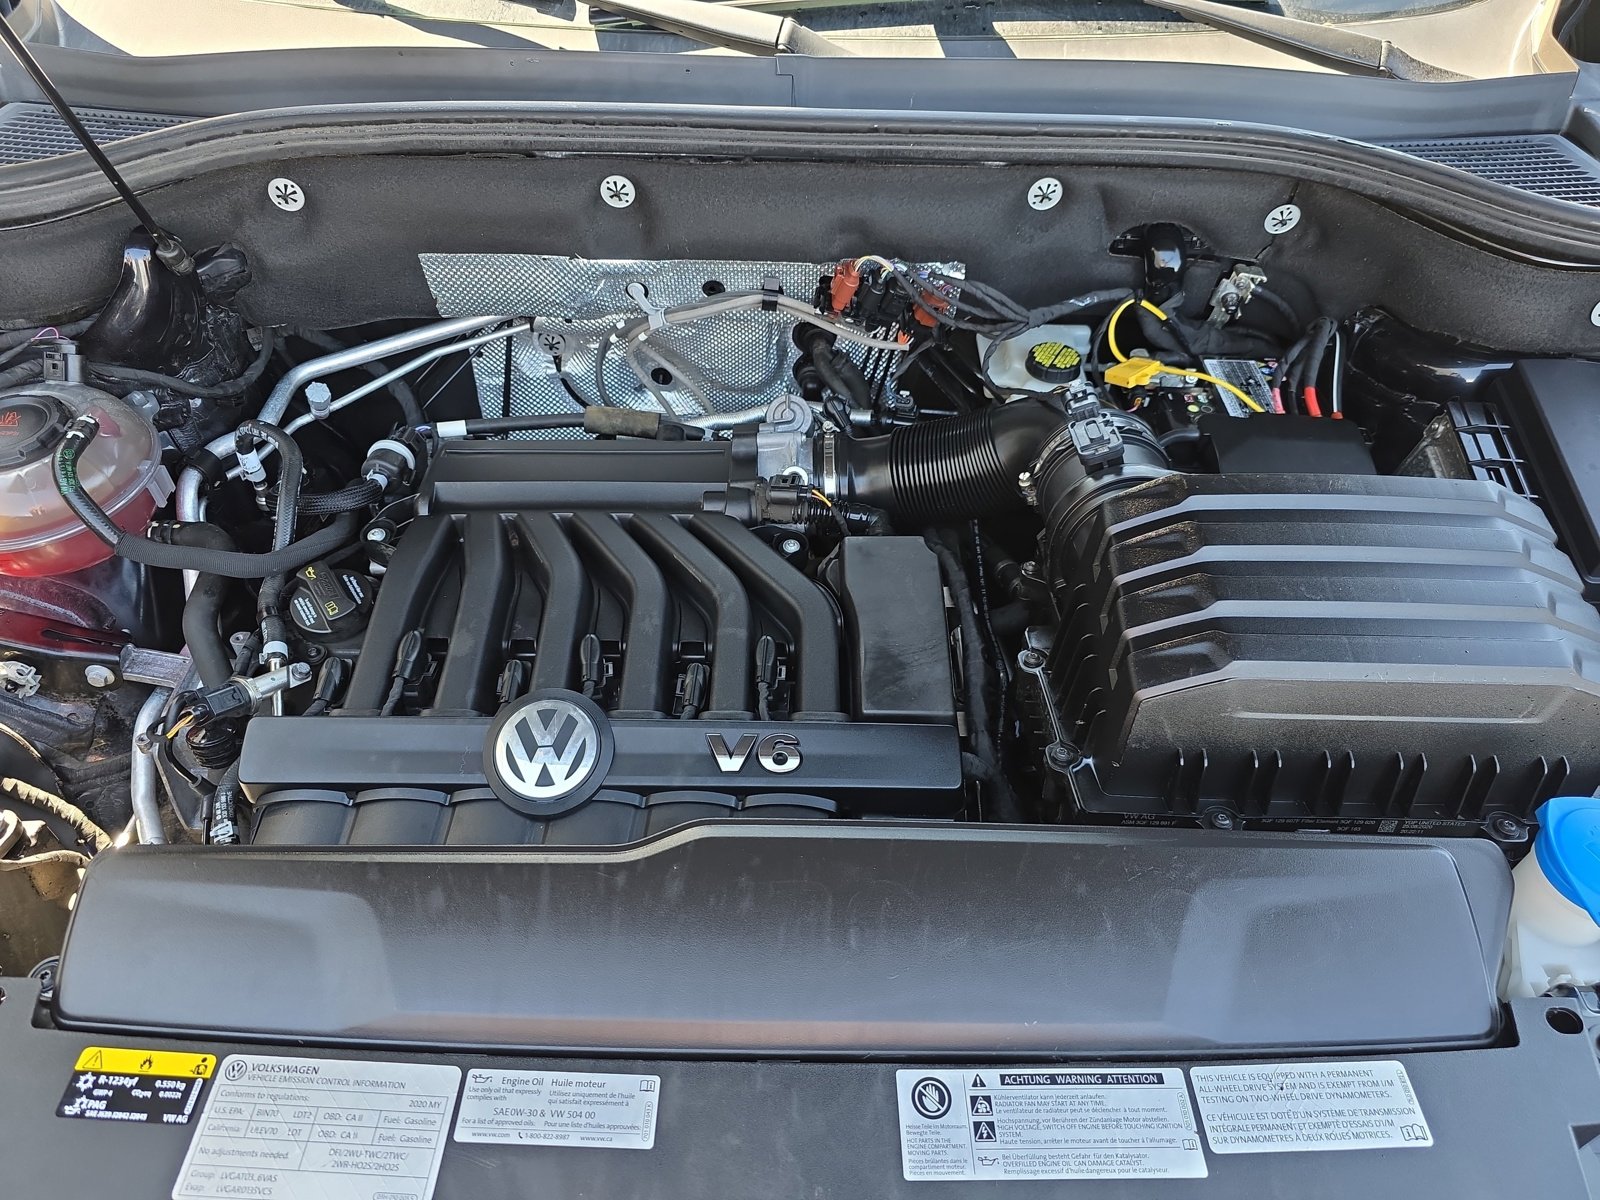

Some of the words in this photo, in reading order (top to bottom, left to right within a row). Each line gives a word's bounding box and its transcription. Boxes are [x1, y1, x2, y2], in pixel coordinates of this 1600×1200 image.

[705, 732, 803, 774] V6
[251, 1063, 320, 1075] VOLKSWAGEN
[1004, 1076, 1050, 1084] ACHTUNG
[1055, 1075, 1102, 1084] WARNING
[1107, 1075, 1158, 1083] ATTENTION
[1257, 1072, 1295, 1080] EQUIPPED
[1327, 1070, 1373, 1078] PERMANENT
[98, 1075, 139, 1088] R-1234yf
[247, 1074, 277, 1082] VEHICLE
[279, 1076, 314, 1084] EMISSION
[316, 1078, 350, 1086] CONTROL
[352, 1080, 406, 1089] INFORMATION
[502, 1077, 530, 1087] Engine
[551, 1079, 573, 1087] Huile
[575, 1080, 606, 1088] moteur
[1200, 1084, 1243, 1093] ALL-WHEEL
[1269, 1083, 1296, 1091] SYSTEM
[1297, 1082, 1316, 1090] AND
[1327, 1081, 1355, 1089] EXEMPT
[1358, 1080, 1379, 1088] FROM
[220, 1090, 256, 1098] Conforms
[1201, 1095, 1234, 1104] TESTING
[1251, 1094, 1299, 1102] TWO-WHEEL
[409, 1100, 427, 1108] 2020
[163, 1113, 174, 1122] VW
[175, 1114, 188, 1123] AG
[550, 1110, 565, 1118] VW
[567, 1111, 583, 1119] 504
[1217, 1111, 1255, 1121] VÉHICULE
[1256, 1112, 1269, 1120] EST
[1271, 1110, 1292, 1119] DOTÉ
[1314, 1108, 1347, 1118] SYSTÈME
[1348, 1109, 1358, 1117] DE
[1360, 1107, 1416, 1116] TRANSMISSION
[404, 1117, 437, 1125] Gasoline
[1210, 1123, 1250, 1133] INTÉGRALE
[1251, 1123, 1297, 1132] PERMANENT
[1308, 1120, 1340, 1130] EXEMPTÉ
[1342, 1120, 1373, 1129] D'ESSAIS
[341, 1131, 350, 1139] CA
[400, 1135, 432, 1144] Gasoline
[1212, 1136, 1228, 1144] SUR
[1230, 1133, 1293, 1144] DYNAMOMÈTRES
[1302, 1133, 1324, 1141] DEUX
[1325, 1132, 1351, 1141] ROUES
[211, 1148, 258, 1157] adjustments
